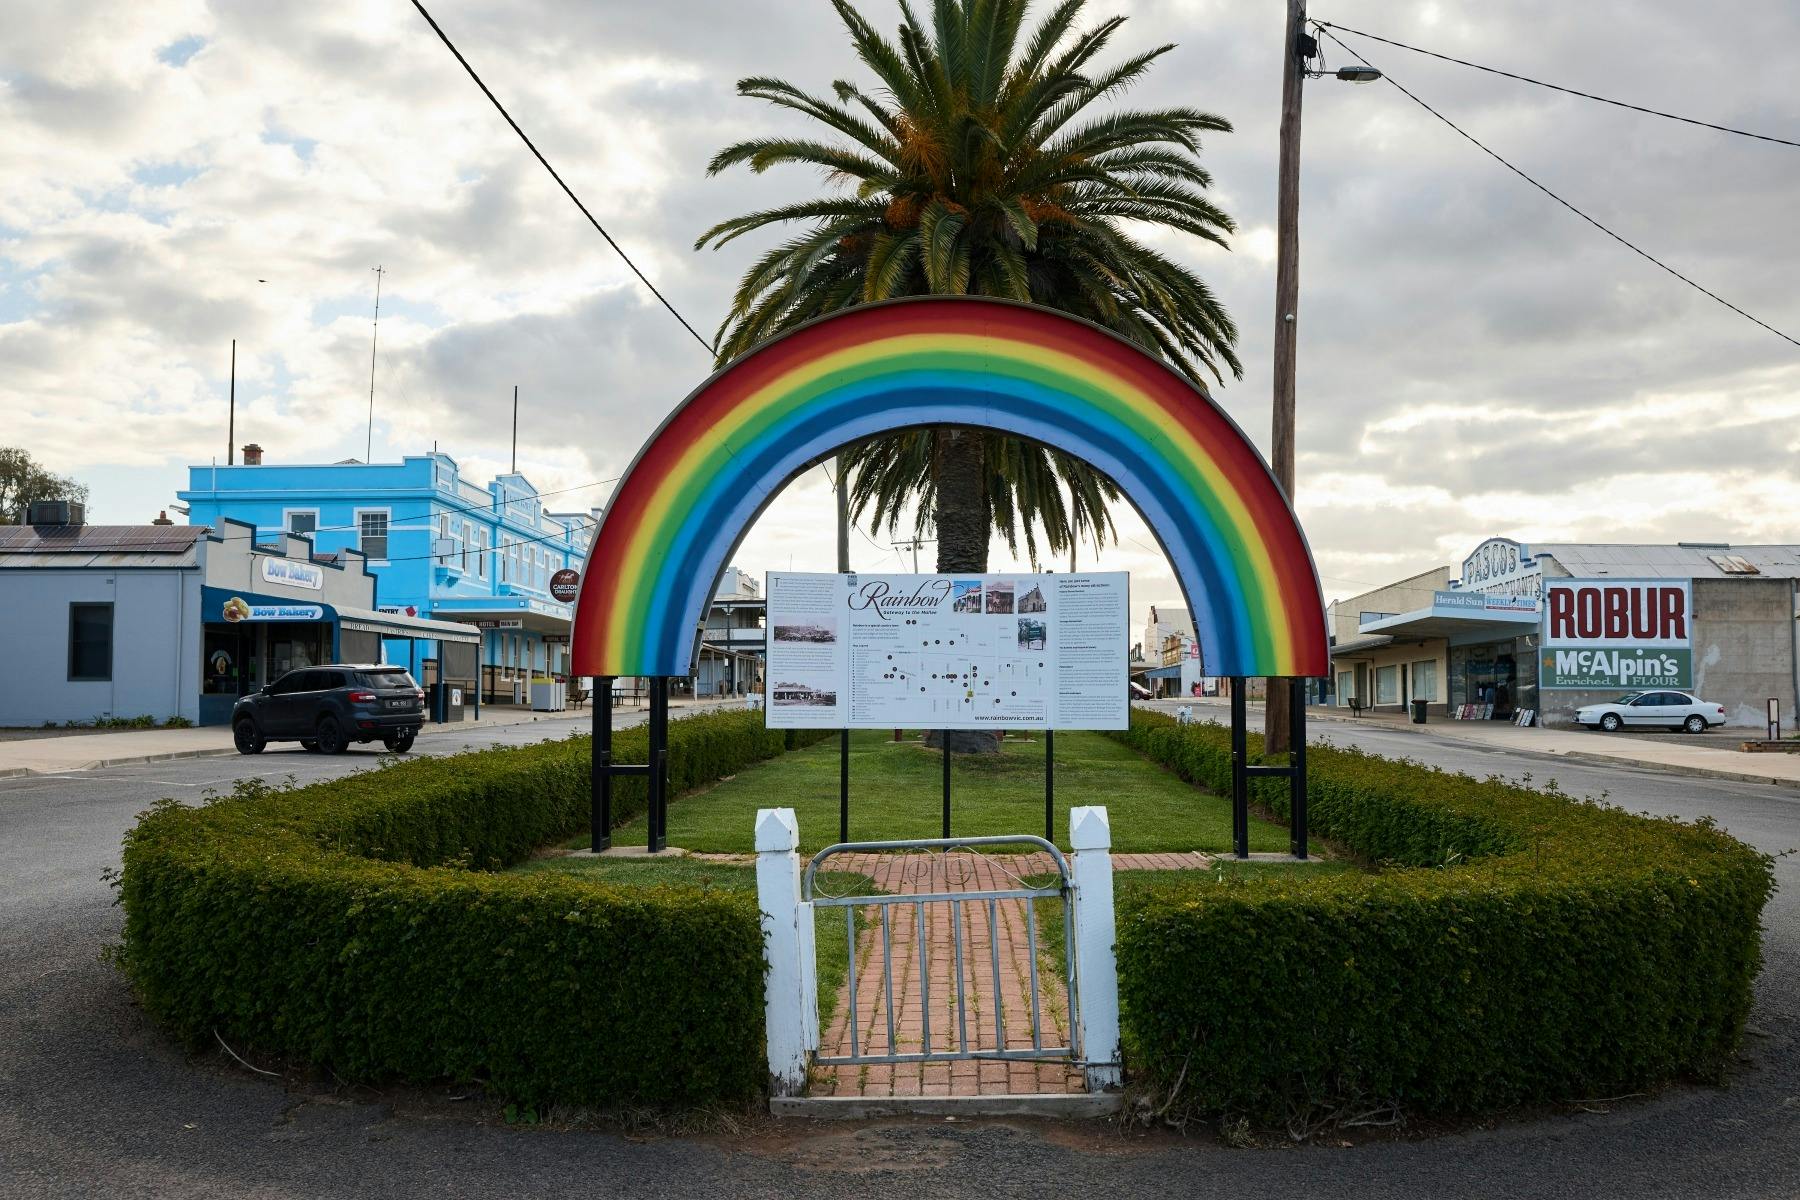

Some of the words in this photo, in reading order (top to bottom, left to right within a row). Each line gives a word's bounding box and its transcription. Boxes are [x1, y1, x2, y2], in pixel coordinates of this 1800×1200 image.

[267, 560, 287, 576] Bow
[288, 562, 318, 587] Bakery
[1467, 543, 1517, 584] PASCOS
[252, 607, 276, 617] Bow
[278, 607, 317, 618] Bakery
[848, 580, 951, 620] Rainbow
[1436, 594, 1465, 605] Herald
[1466, 597, 1484, 606] Sun
[1549, 587, 1688, 640] ROBUR
[1556, 649, 1679, 685] McAlpin's
[1556, 676, 1615, 686] Enriched,
[1633, 677, 1679, 685] FLOUR
